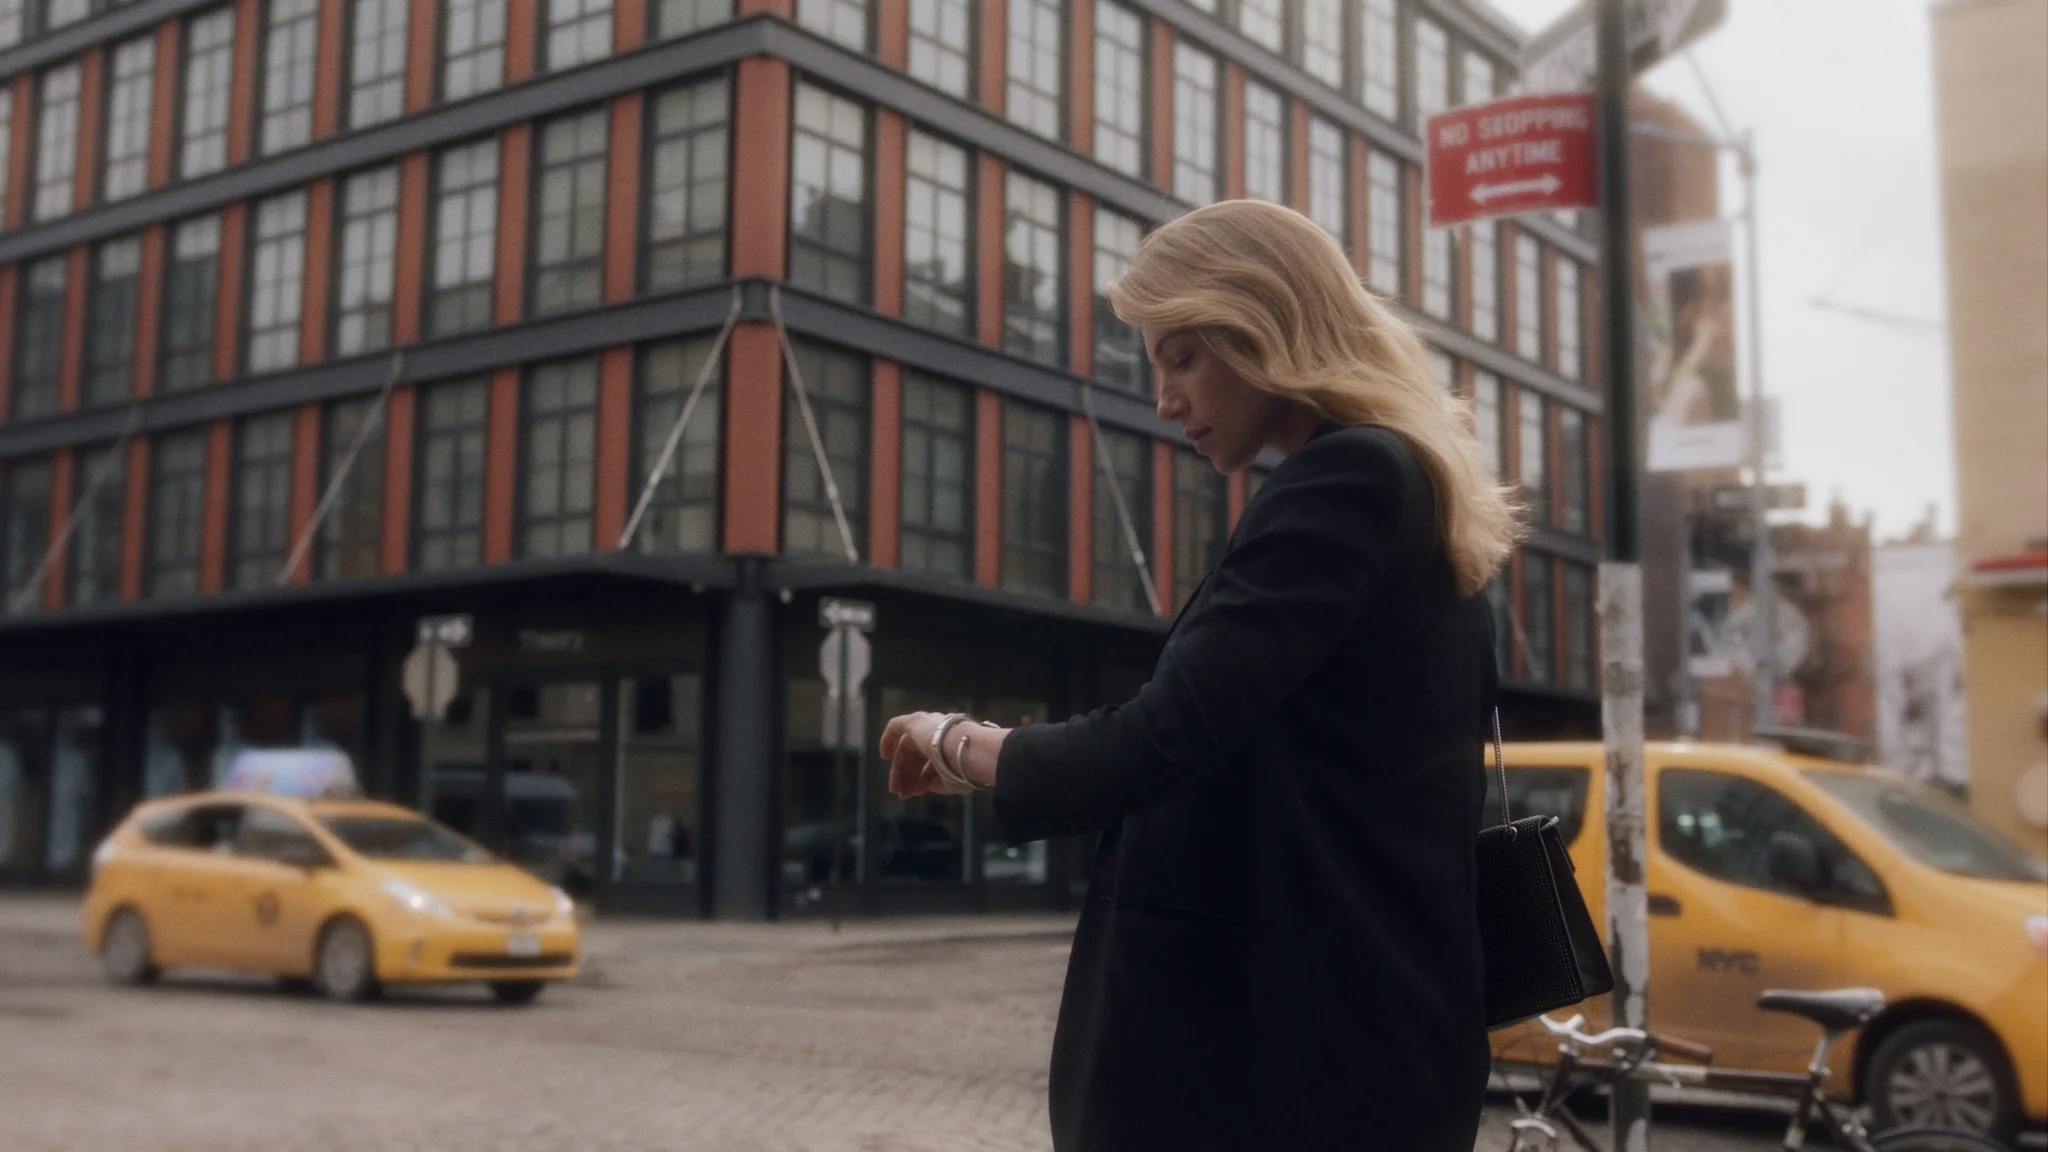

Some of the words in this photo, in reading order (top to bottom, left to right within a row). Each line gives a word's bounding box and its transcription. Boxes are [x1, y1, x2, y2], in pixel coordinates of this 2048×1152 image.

[1439, 121, 1469, 149] NO
[1478, 106, 1589, 140] STOPPING
[1466, 139, 1562, 175] ANYTIME
[1697, 948, 1759, 977] NYC
